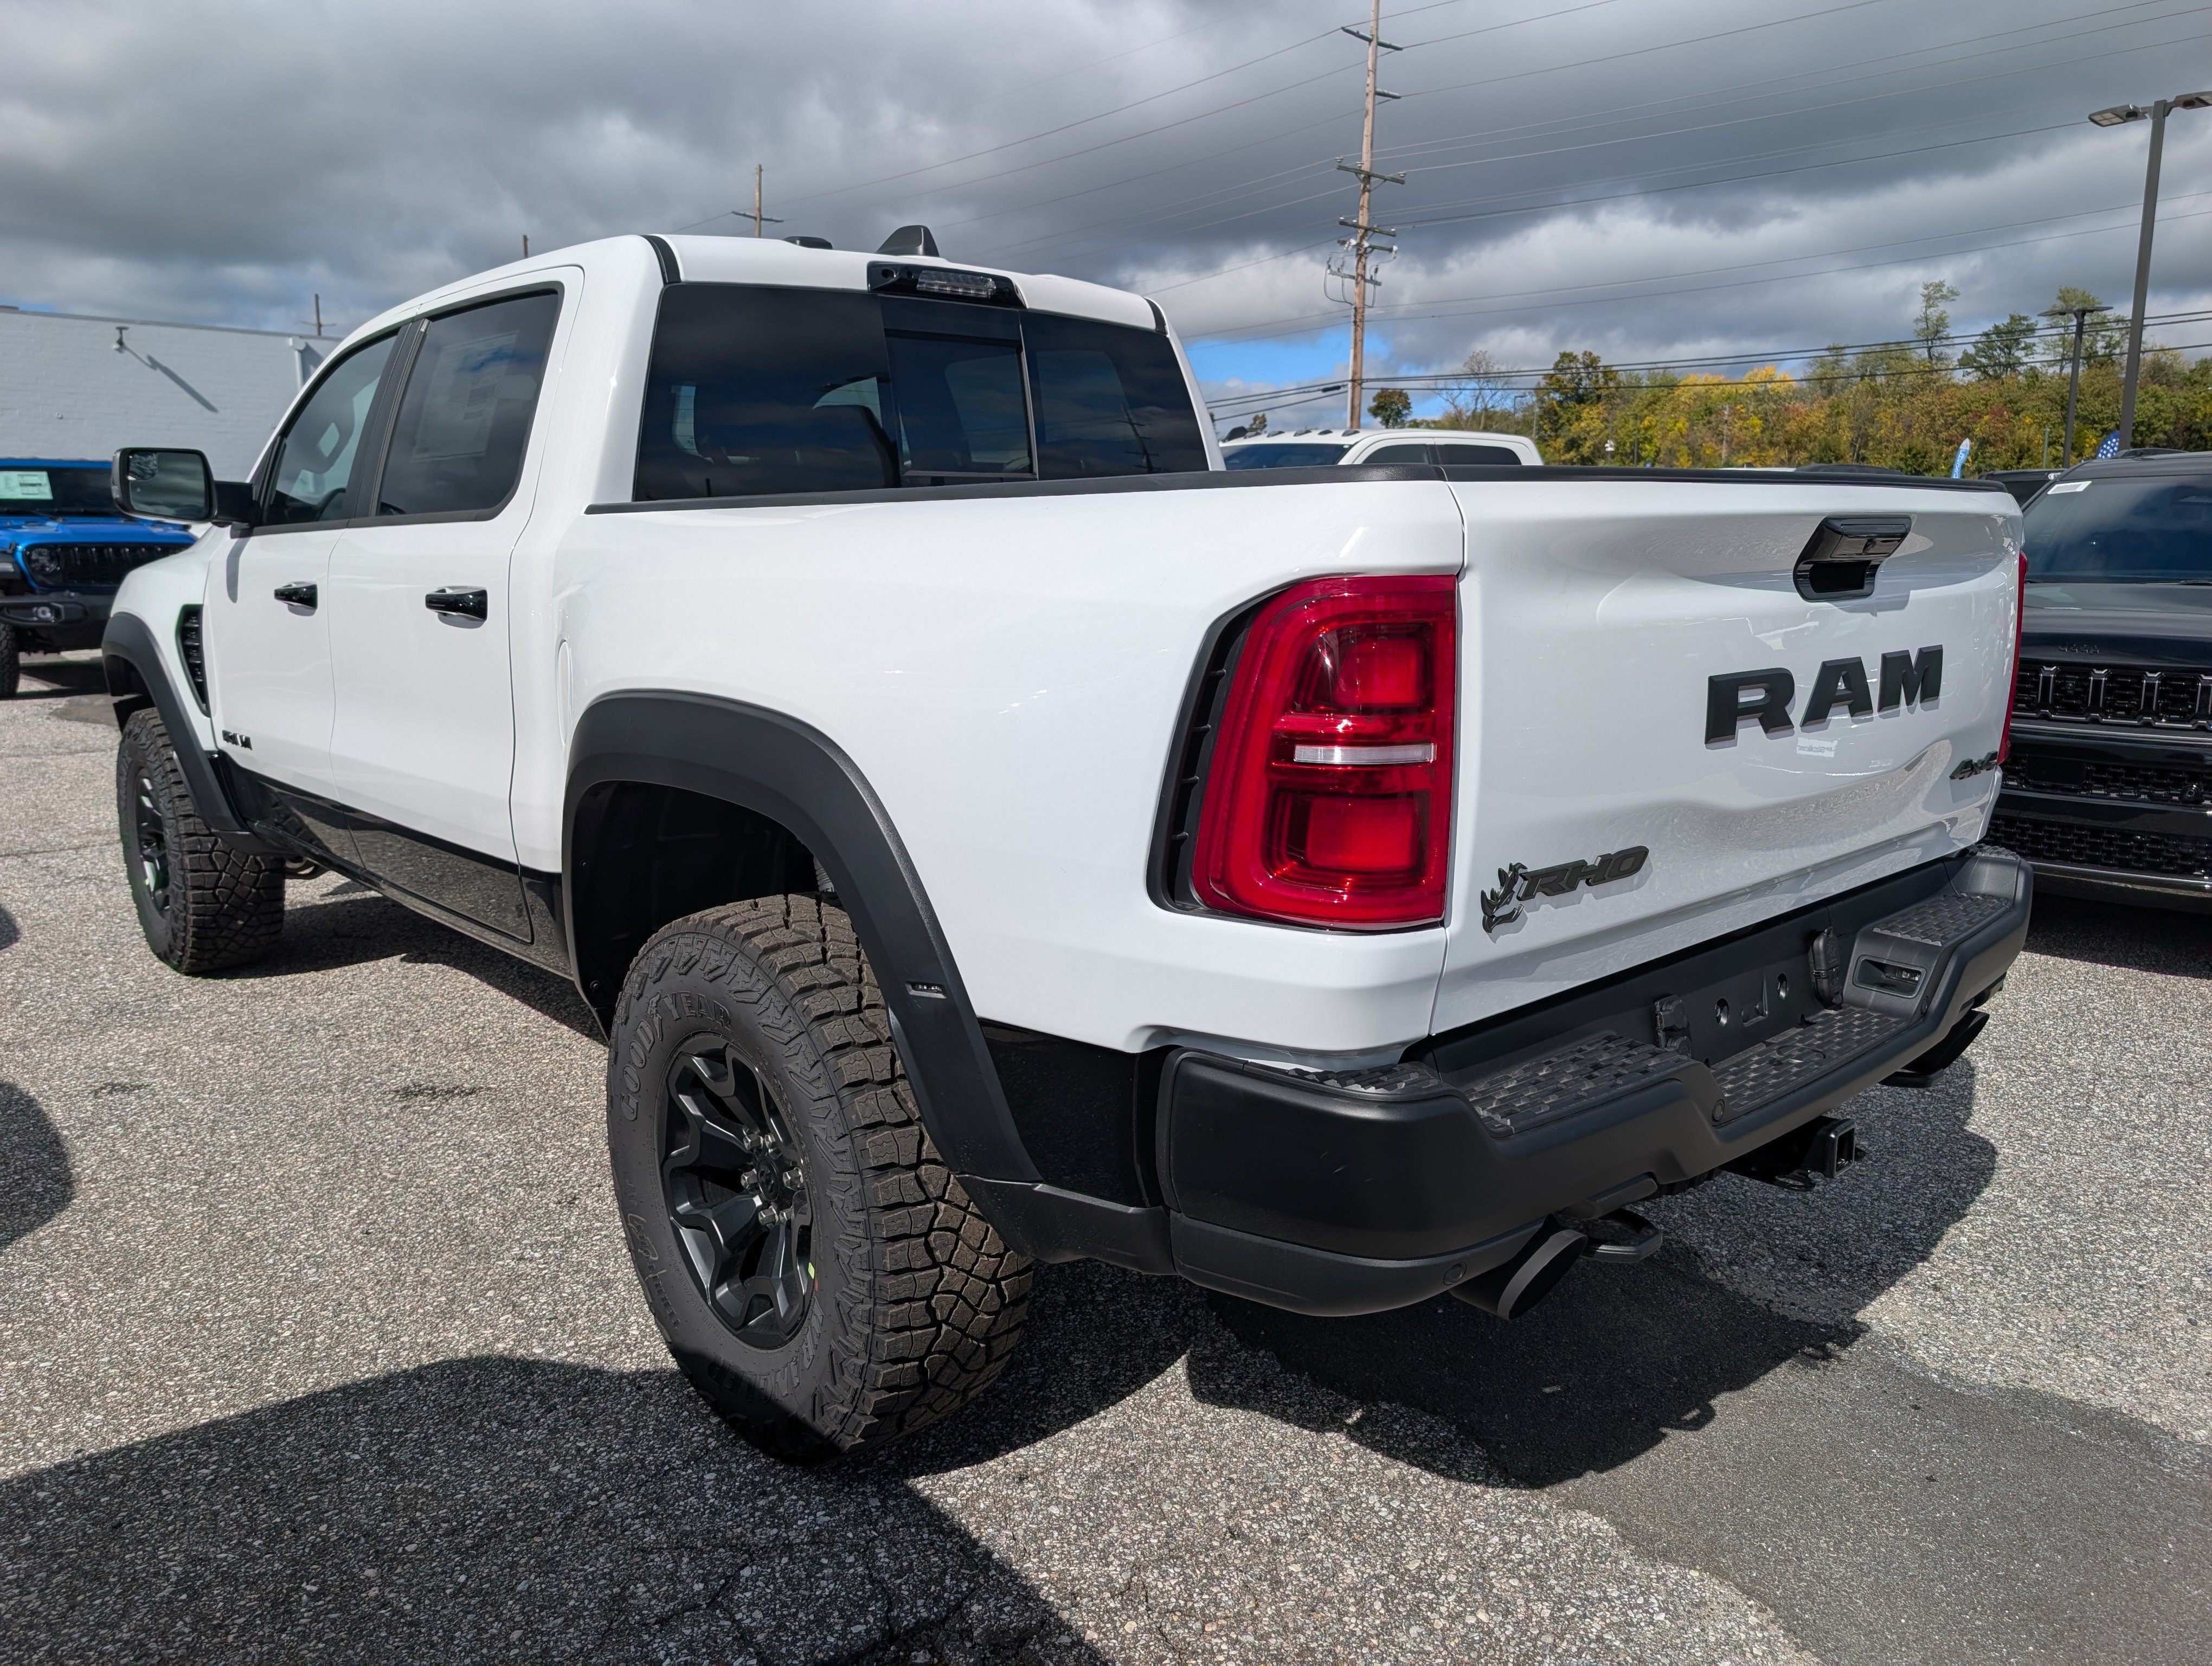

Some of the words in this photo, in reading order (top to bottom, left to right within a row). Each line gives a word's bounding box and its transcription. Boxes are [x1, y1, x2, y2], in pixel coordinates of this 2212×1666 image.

[1705, 644, 1943, 745] RAM
[1516, 845, 1649, 902] RHO
[620, 991, 732, 1121] GOODYEAR
